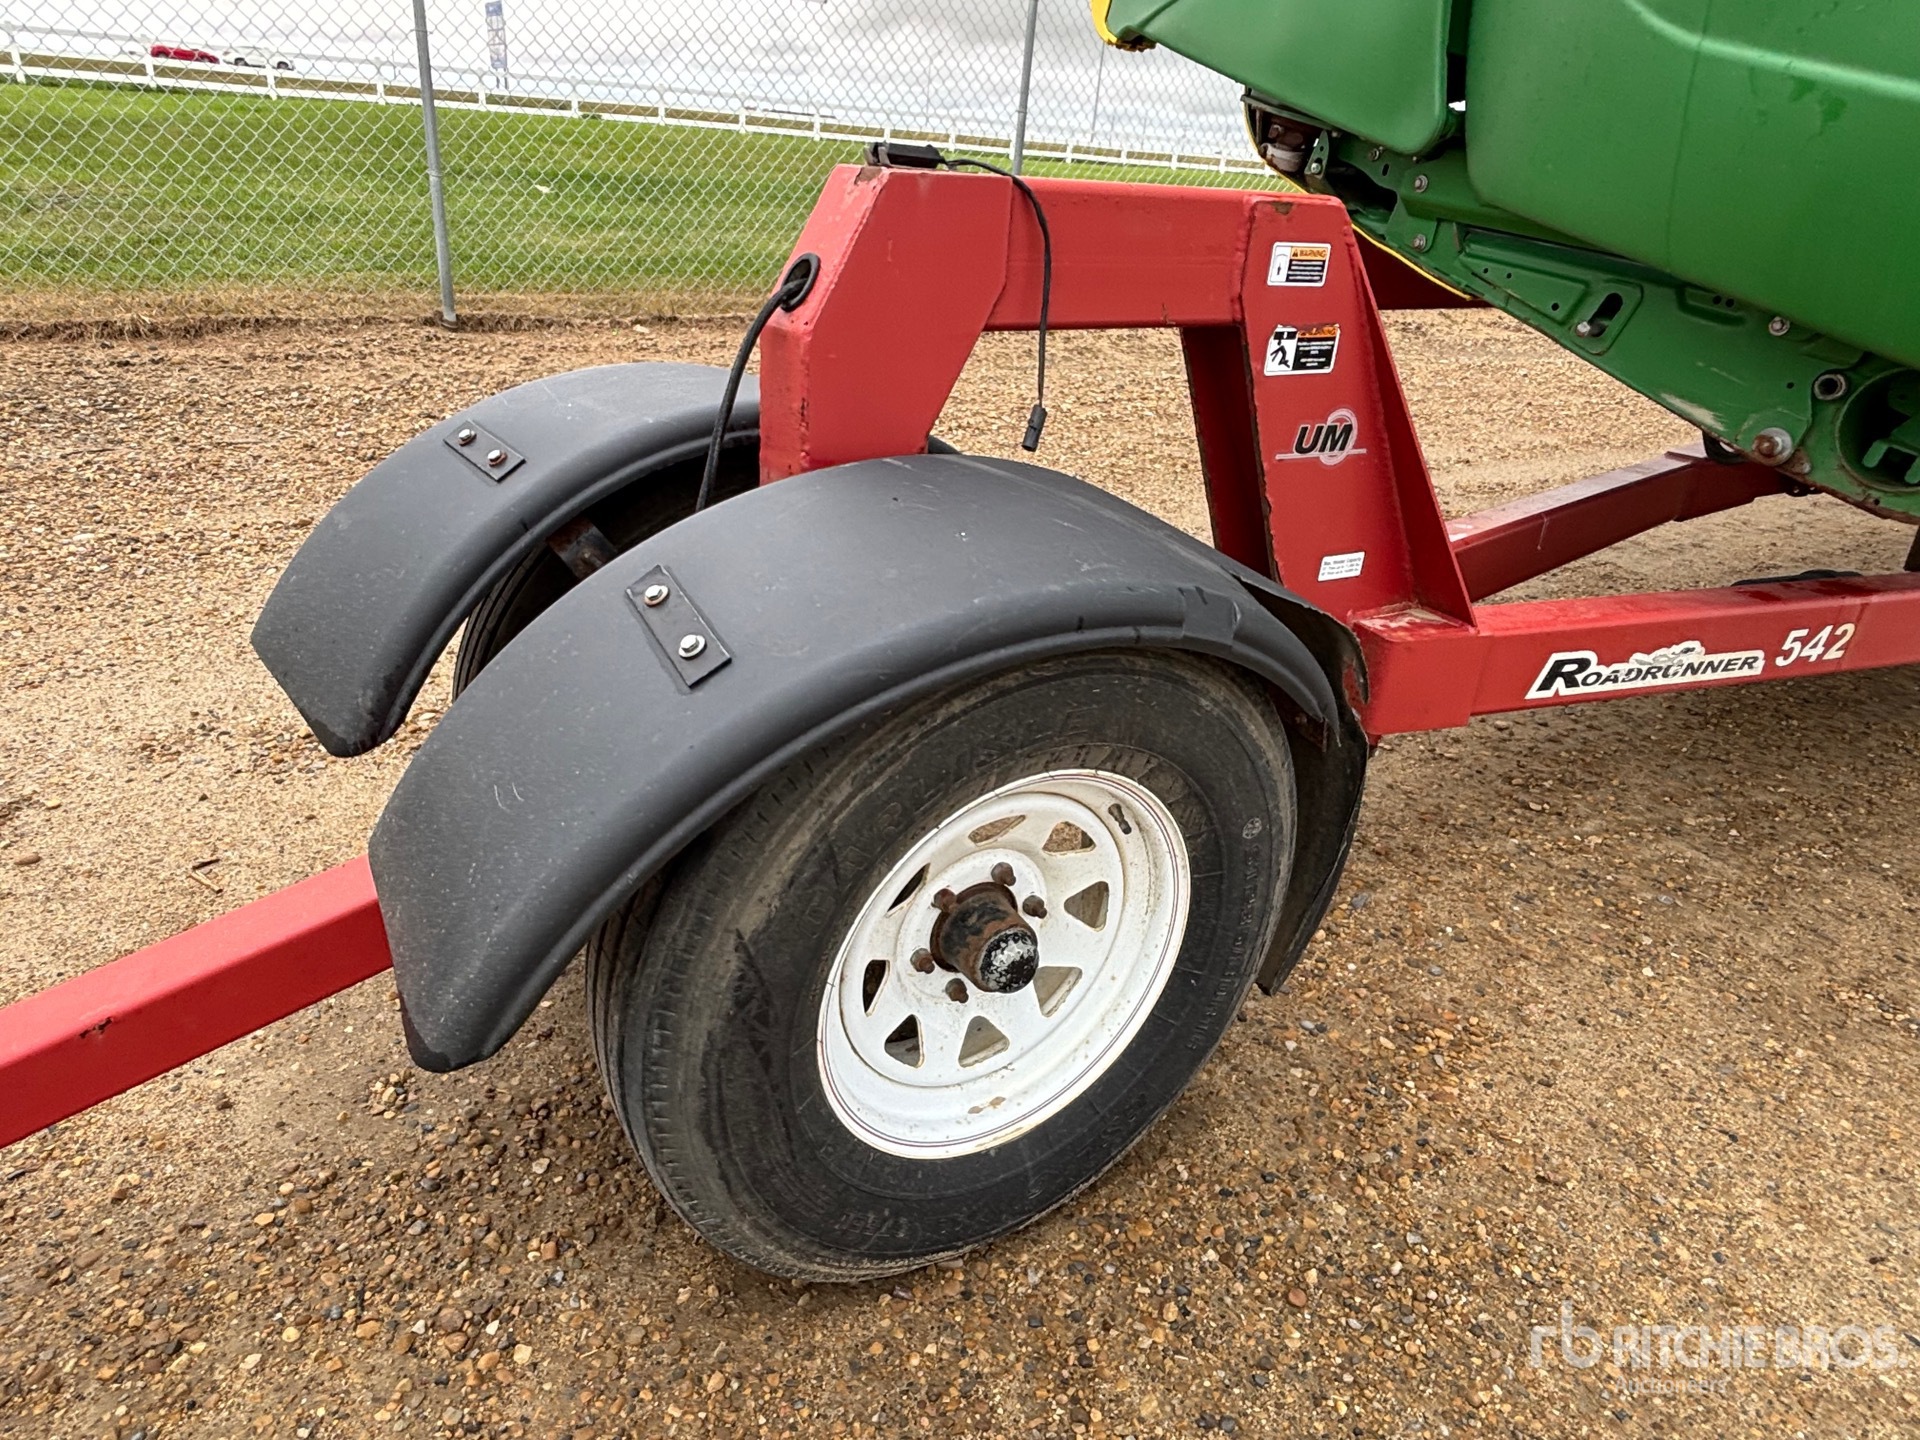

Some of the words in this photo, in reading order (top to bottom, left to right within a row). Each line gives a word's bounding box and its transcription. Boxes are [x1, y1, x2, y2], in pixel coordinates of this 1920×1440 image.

[1295, 423, 1353, 455] UM
[1536, 655, 1760, 692] ROADRUNNER
[1775, 623, 1856, 667] 542
